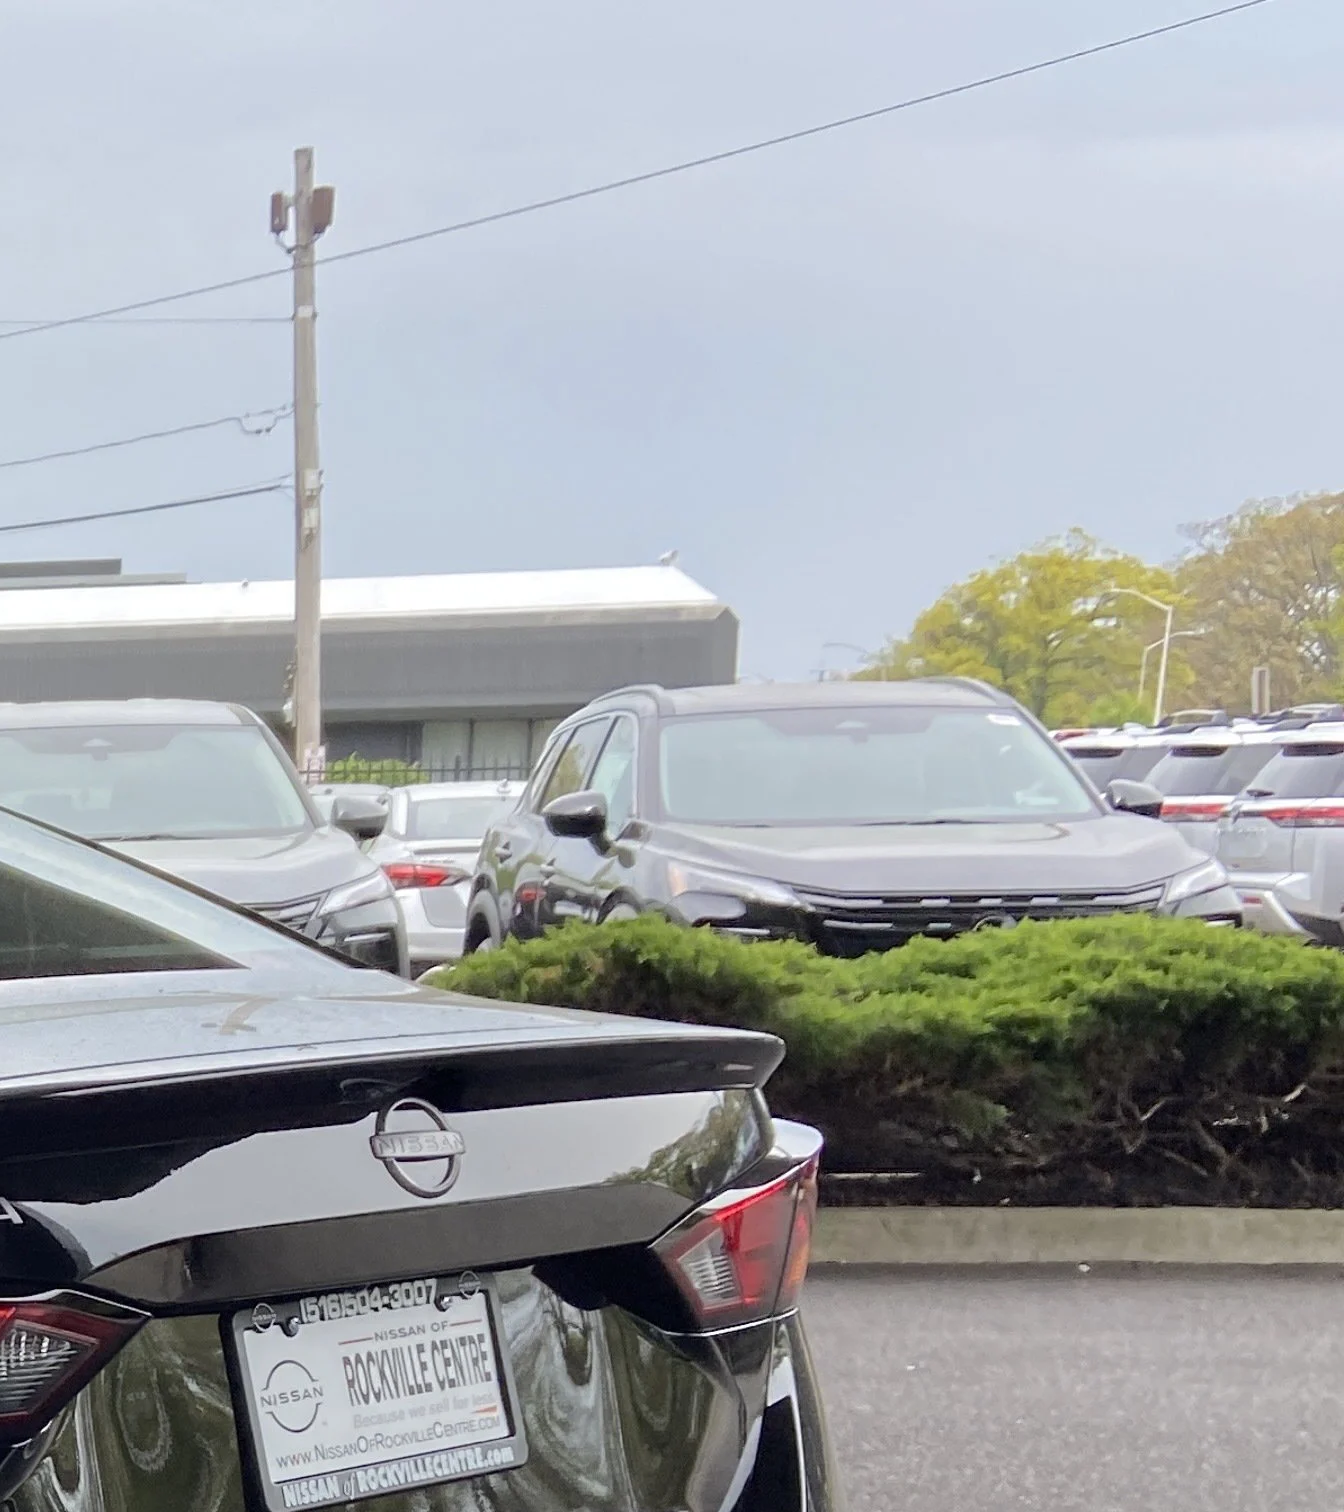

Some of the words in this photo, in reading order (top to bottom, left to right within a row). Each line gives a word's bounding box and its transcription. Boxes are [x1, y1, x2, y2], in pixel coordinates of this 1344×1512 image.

[377, 1133, 464, 1156] NISSAN
[374, 1324, 426, 1342] NISSAN
[430, 1320, 449, 1334] OF
[342, 1343, 433, 1407] ROCKVILLE
[431, 1333, 491, 1391] CENTRE
[260, 1386, 324, 1408] NISSAN
[353, 1410, 405, 1428] Because
[282, 1475, 340, 1508] NISSAN
[343, 1471, 358, 1500] of
